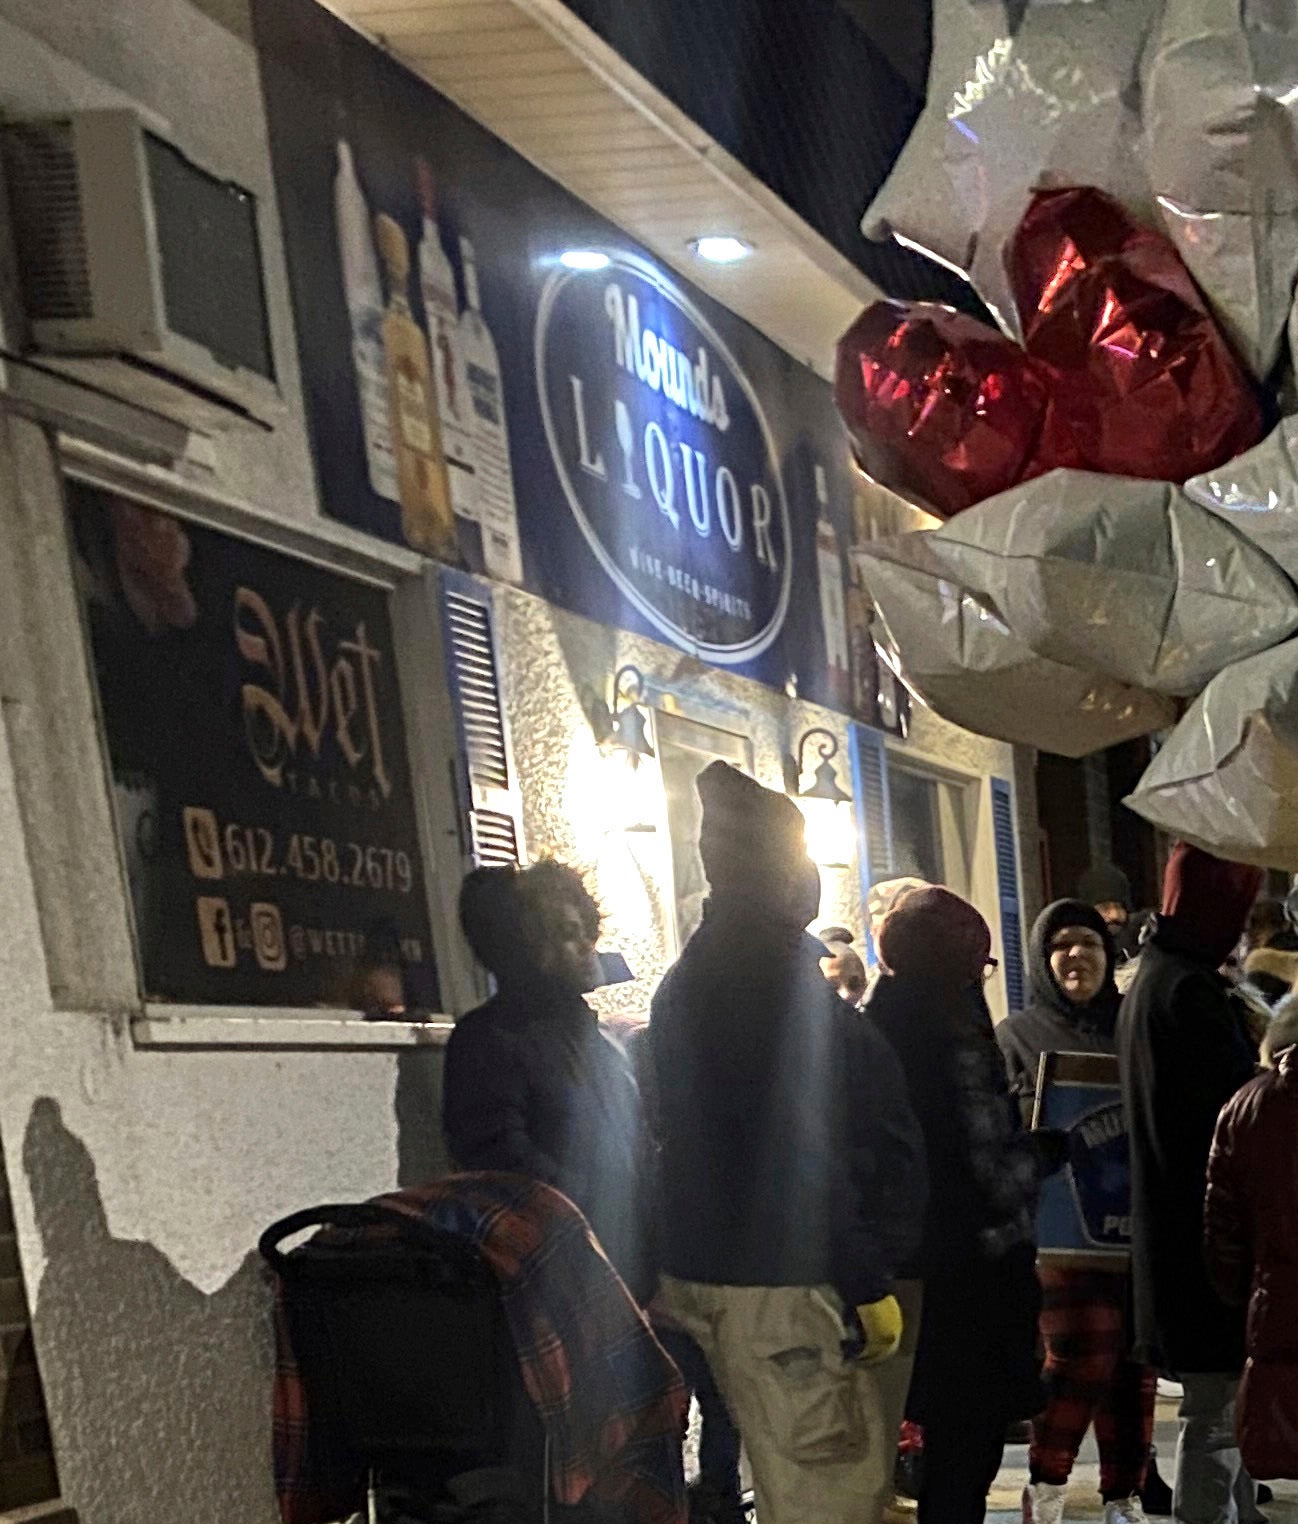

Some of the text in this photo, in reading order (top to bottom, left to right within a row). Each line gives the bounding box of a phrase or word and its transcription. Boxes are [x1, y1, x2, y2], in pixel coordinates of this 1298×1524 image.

[604, 283, 730, 432] Mounds
[234, 586, 392, 799] Wet
[225, 824, 412, 893] 612.458.2679
